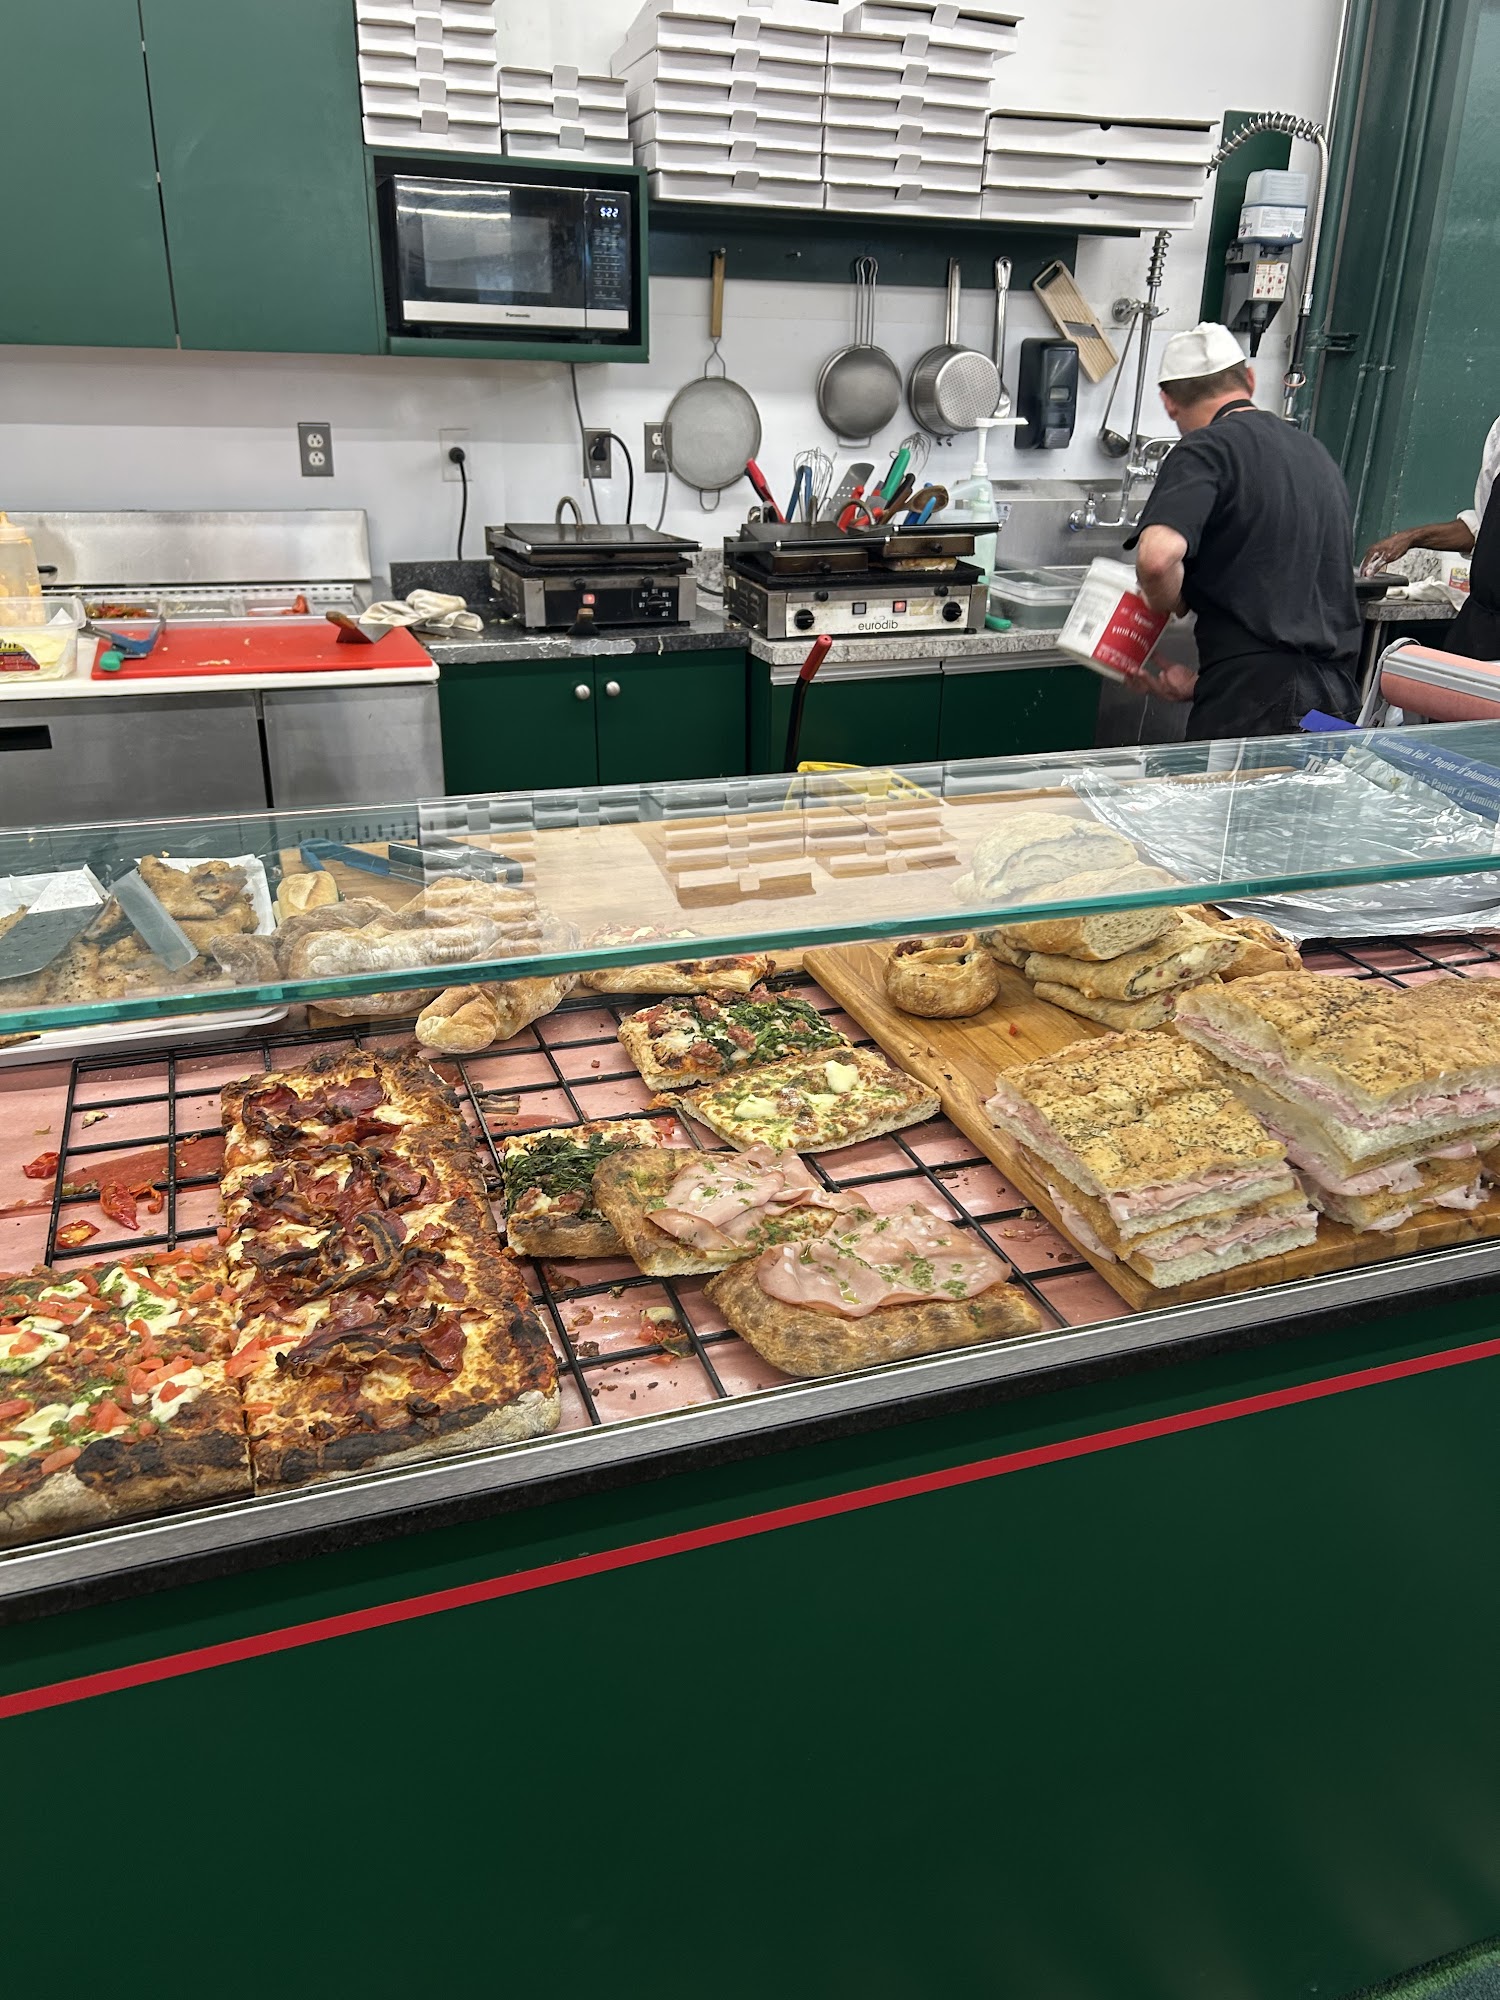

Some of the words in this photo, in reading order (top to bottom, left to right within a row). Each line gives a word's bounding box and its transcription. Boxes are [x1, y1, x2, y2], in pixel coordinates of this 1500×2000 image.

[858, 620, 898, 630] eurodib
[1376, 736, 1414, 755] Aluminum
[1411, 748, 1429, 760] Foil
[1431, 756, 1459, 773] Papier
[1456, 766, 1500, 789] d'aluminiu
[1431, 778, 1458, 795] Papier
[1456, 787, 1500, 811] d'aluminiu
